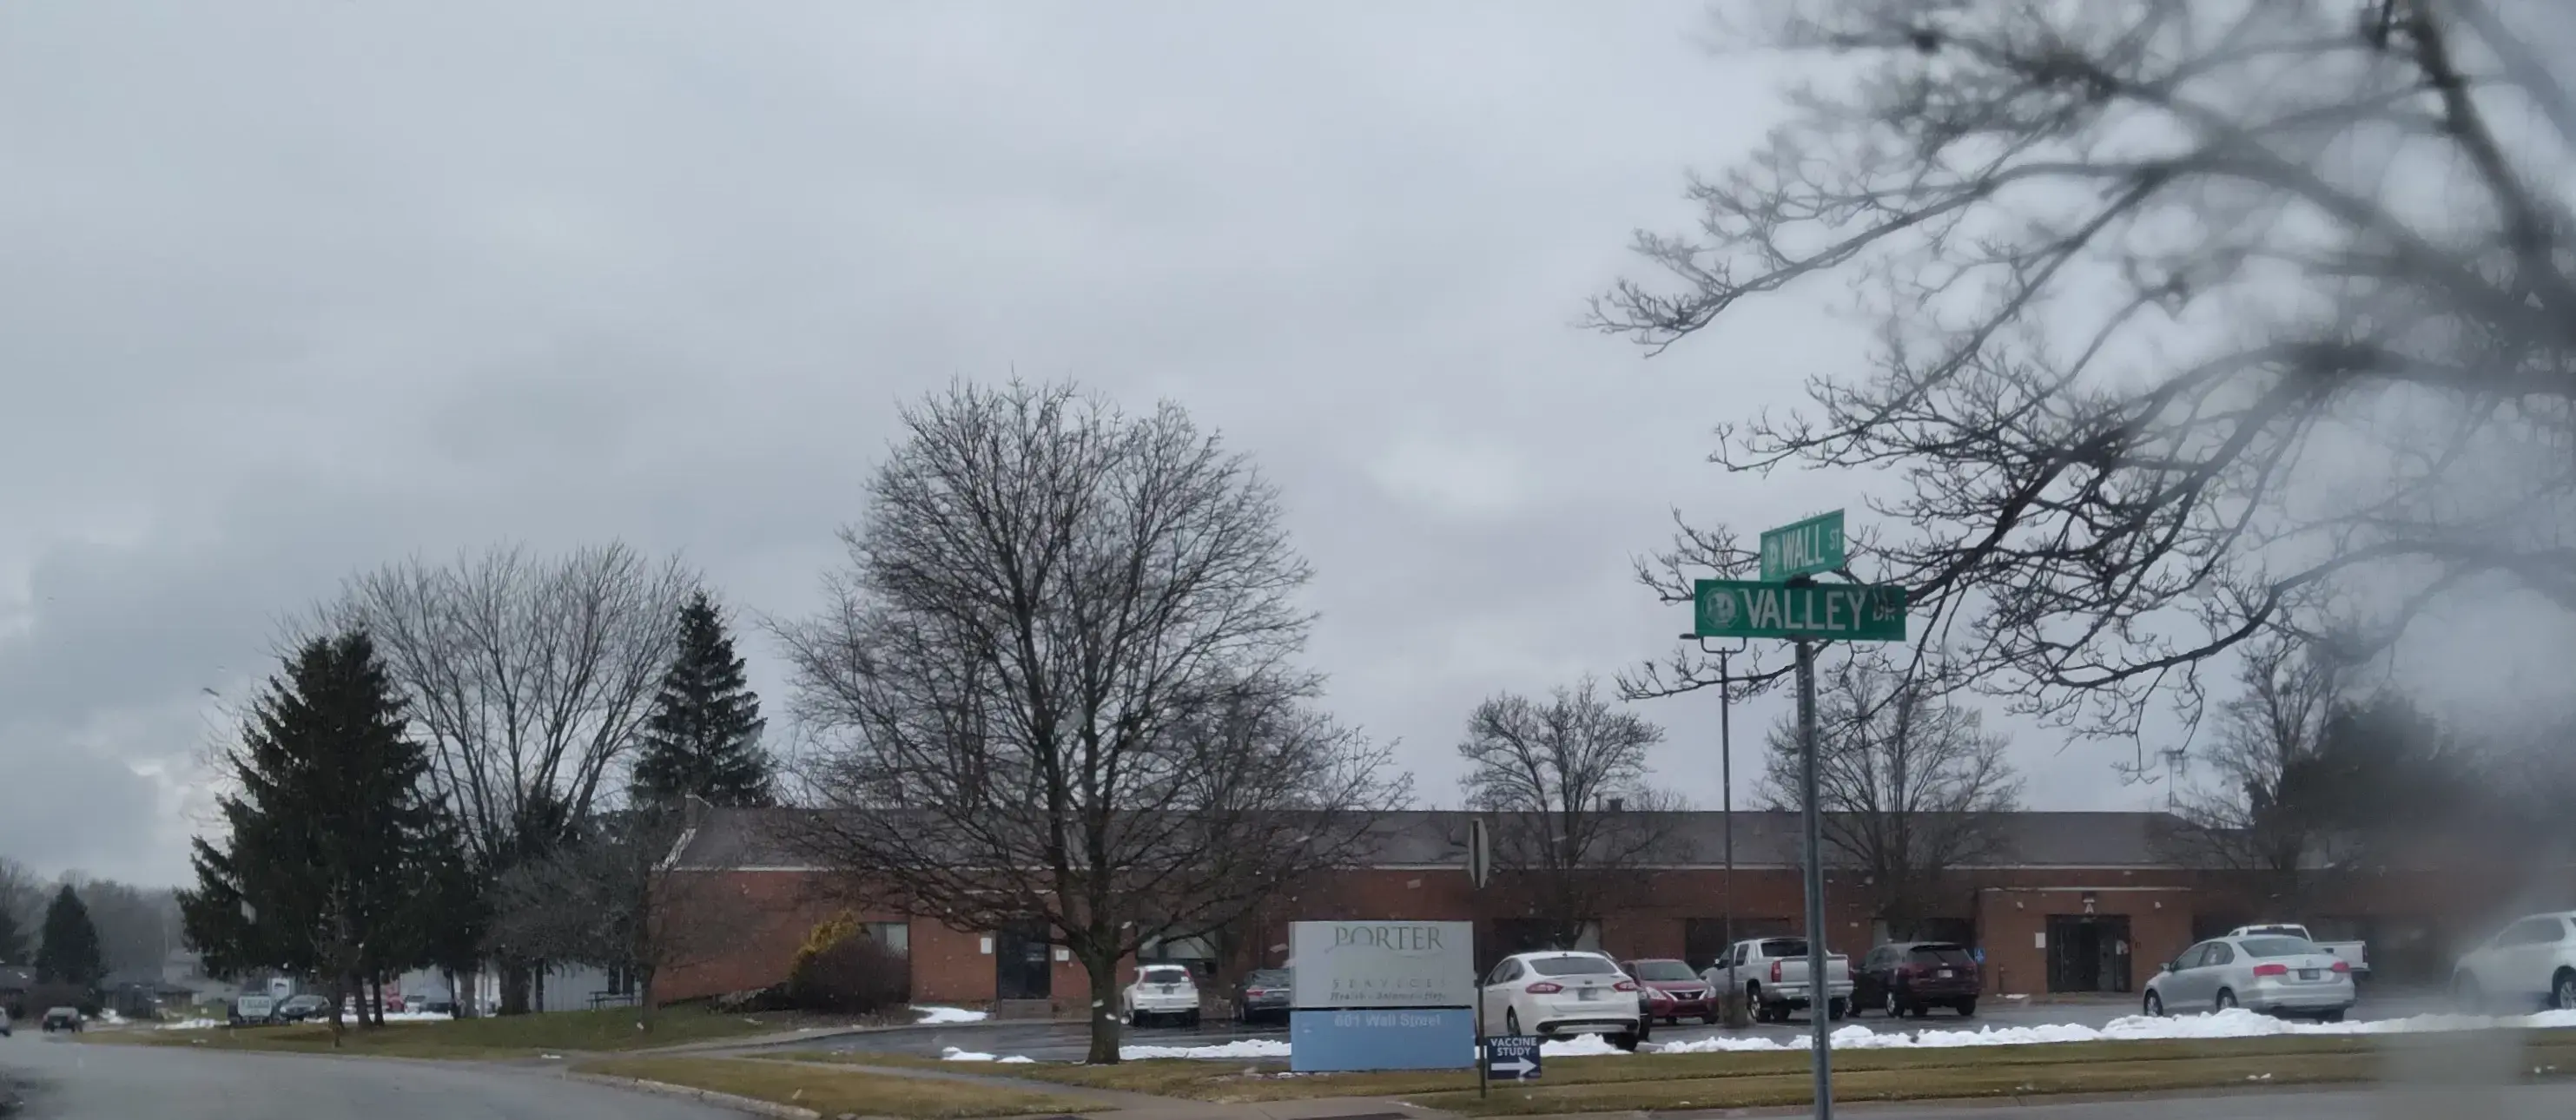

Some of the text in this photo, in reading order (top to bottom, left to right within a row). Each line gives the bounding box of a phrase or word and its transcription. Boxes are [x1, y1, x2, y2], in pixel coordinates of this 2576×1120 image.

[1782, 524, 1840, 571] WALL ST
[1740, 588, 1867, 630] VALLEY
[1334, 926, 1445, 951] PORTER
[1365, 1012, 1397, 1027] Wall
[1400, 1012, 1442, 1027] Street
[1490, 1038, 1537, 1047] VACCINE
[1497, 1047, 1531, 1057] STUDY
